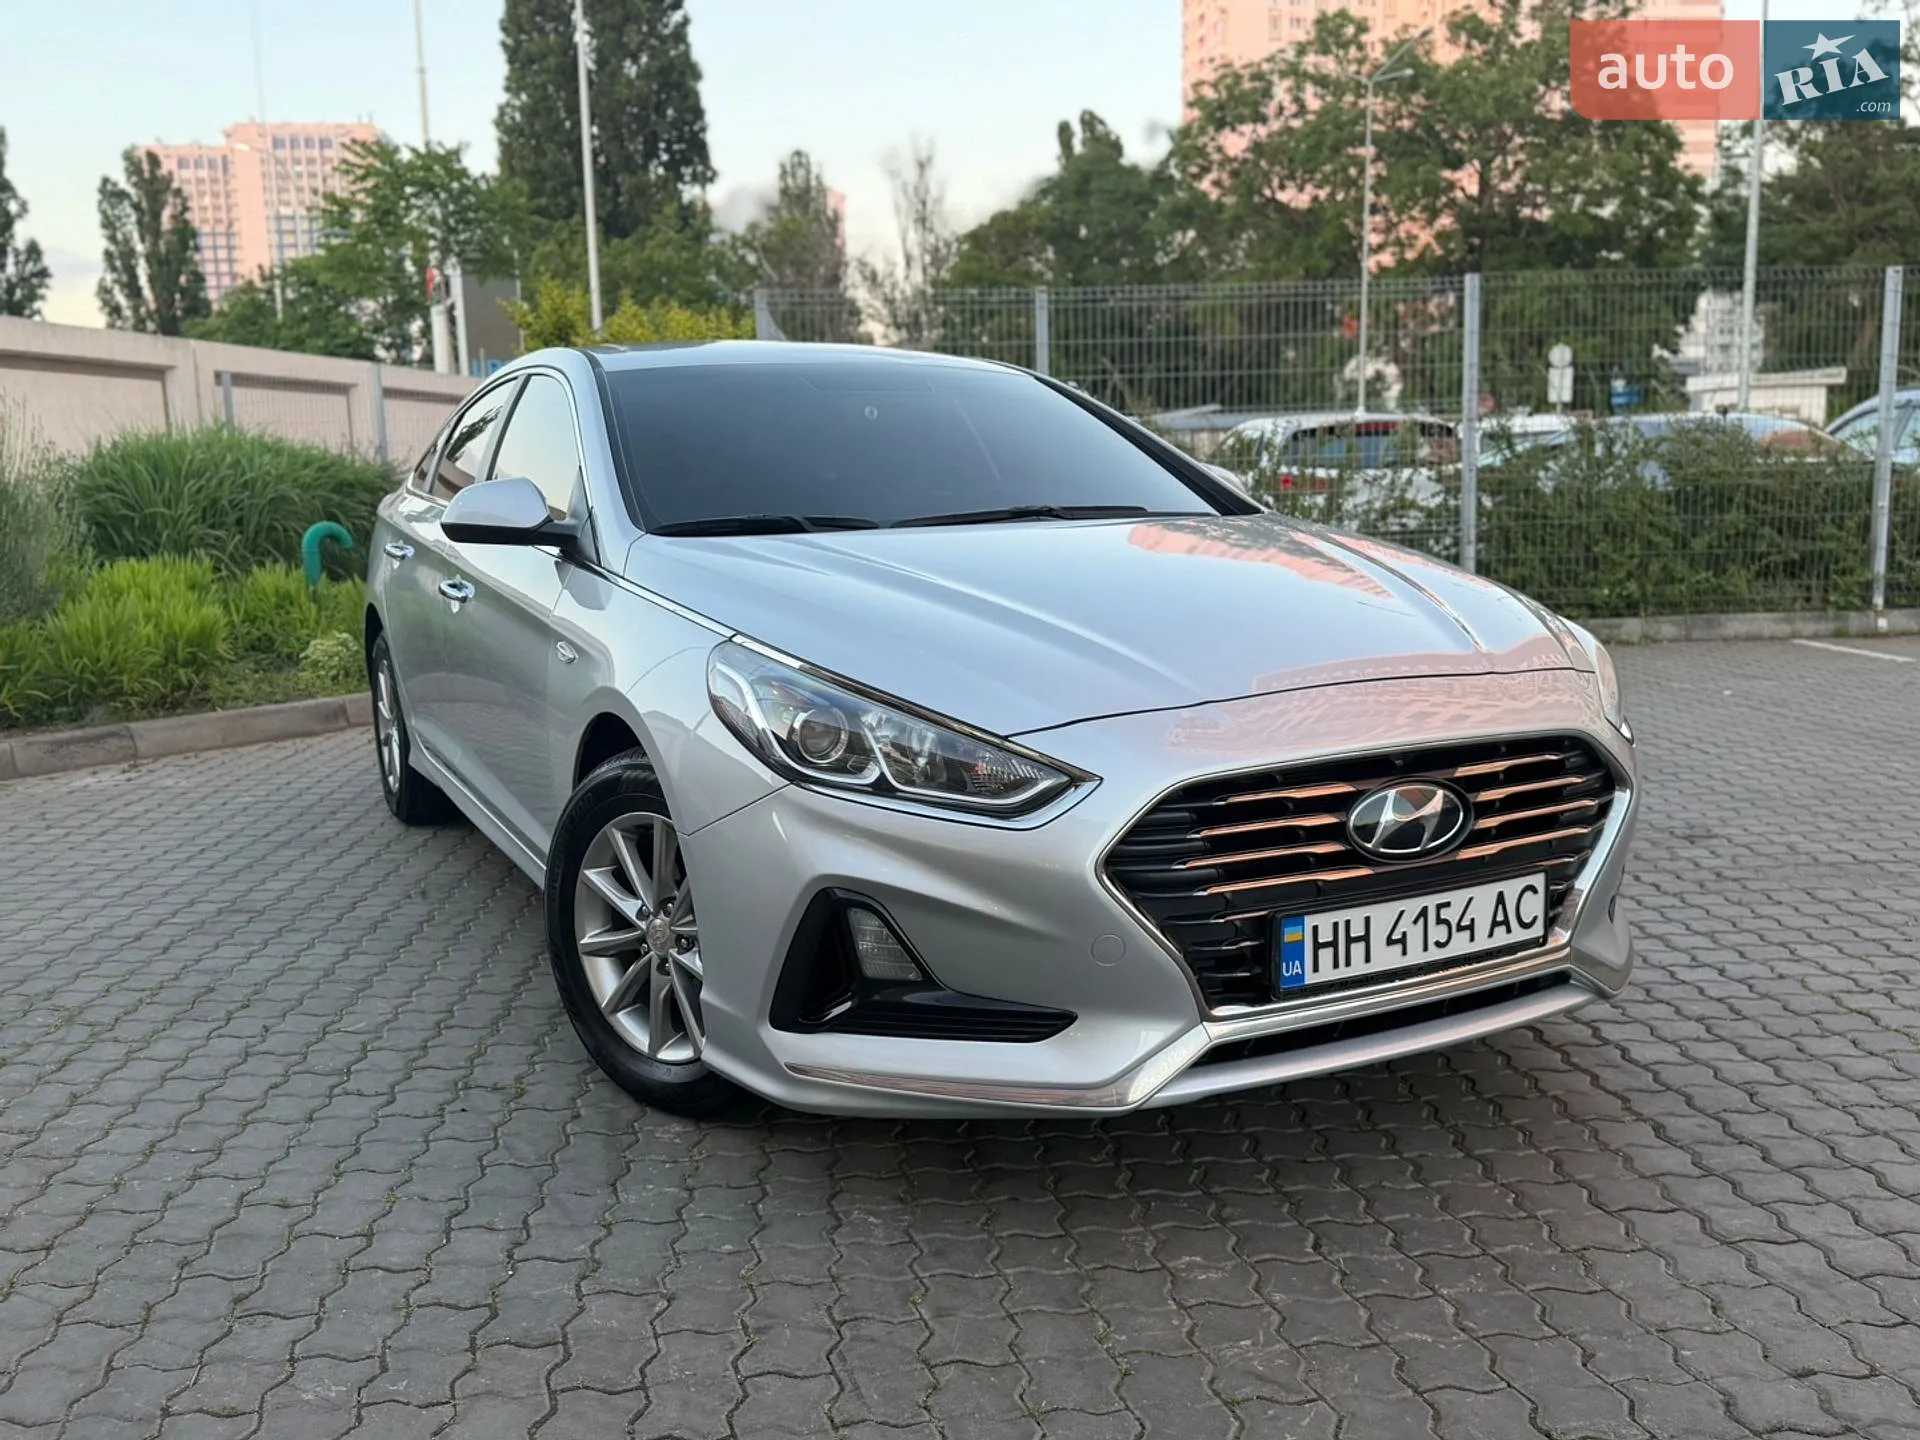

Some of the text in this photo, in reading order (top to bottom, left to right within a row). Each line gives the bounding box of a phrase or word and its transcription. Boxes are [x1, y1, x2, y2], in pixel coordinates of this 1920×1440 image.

[1311, 883, 1540, 973] HH 4154 AC
[1282, 960, 1303, 977] UA
